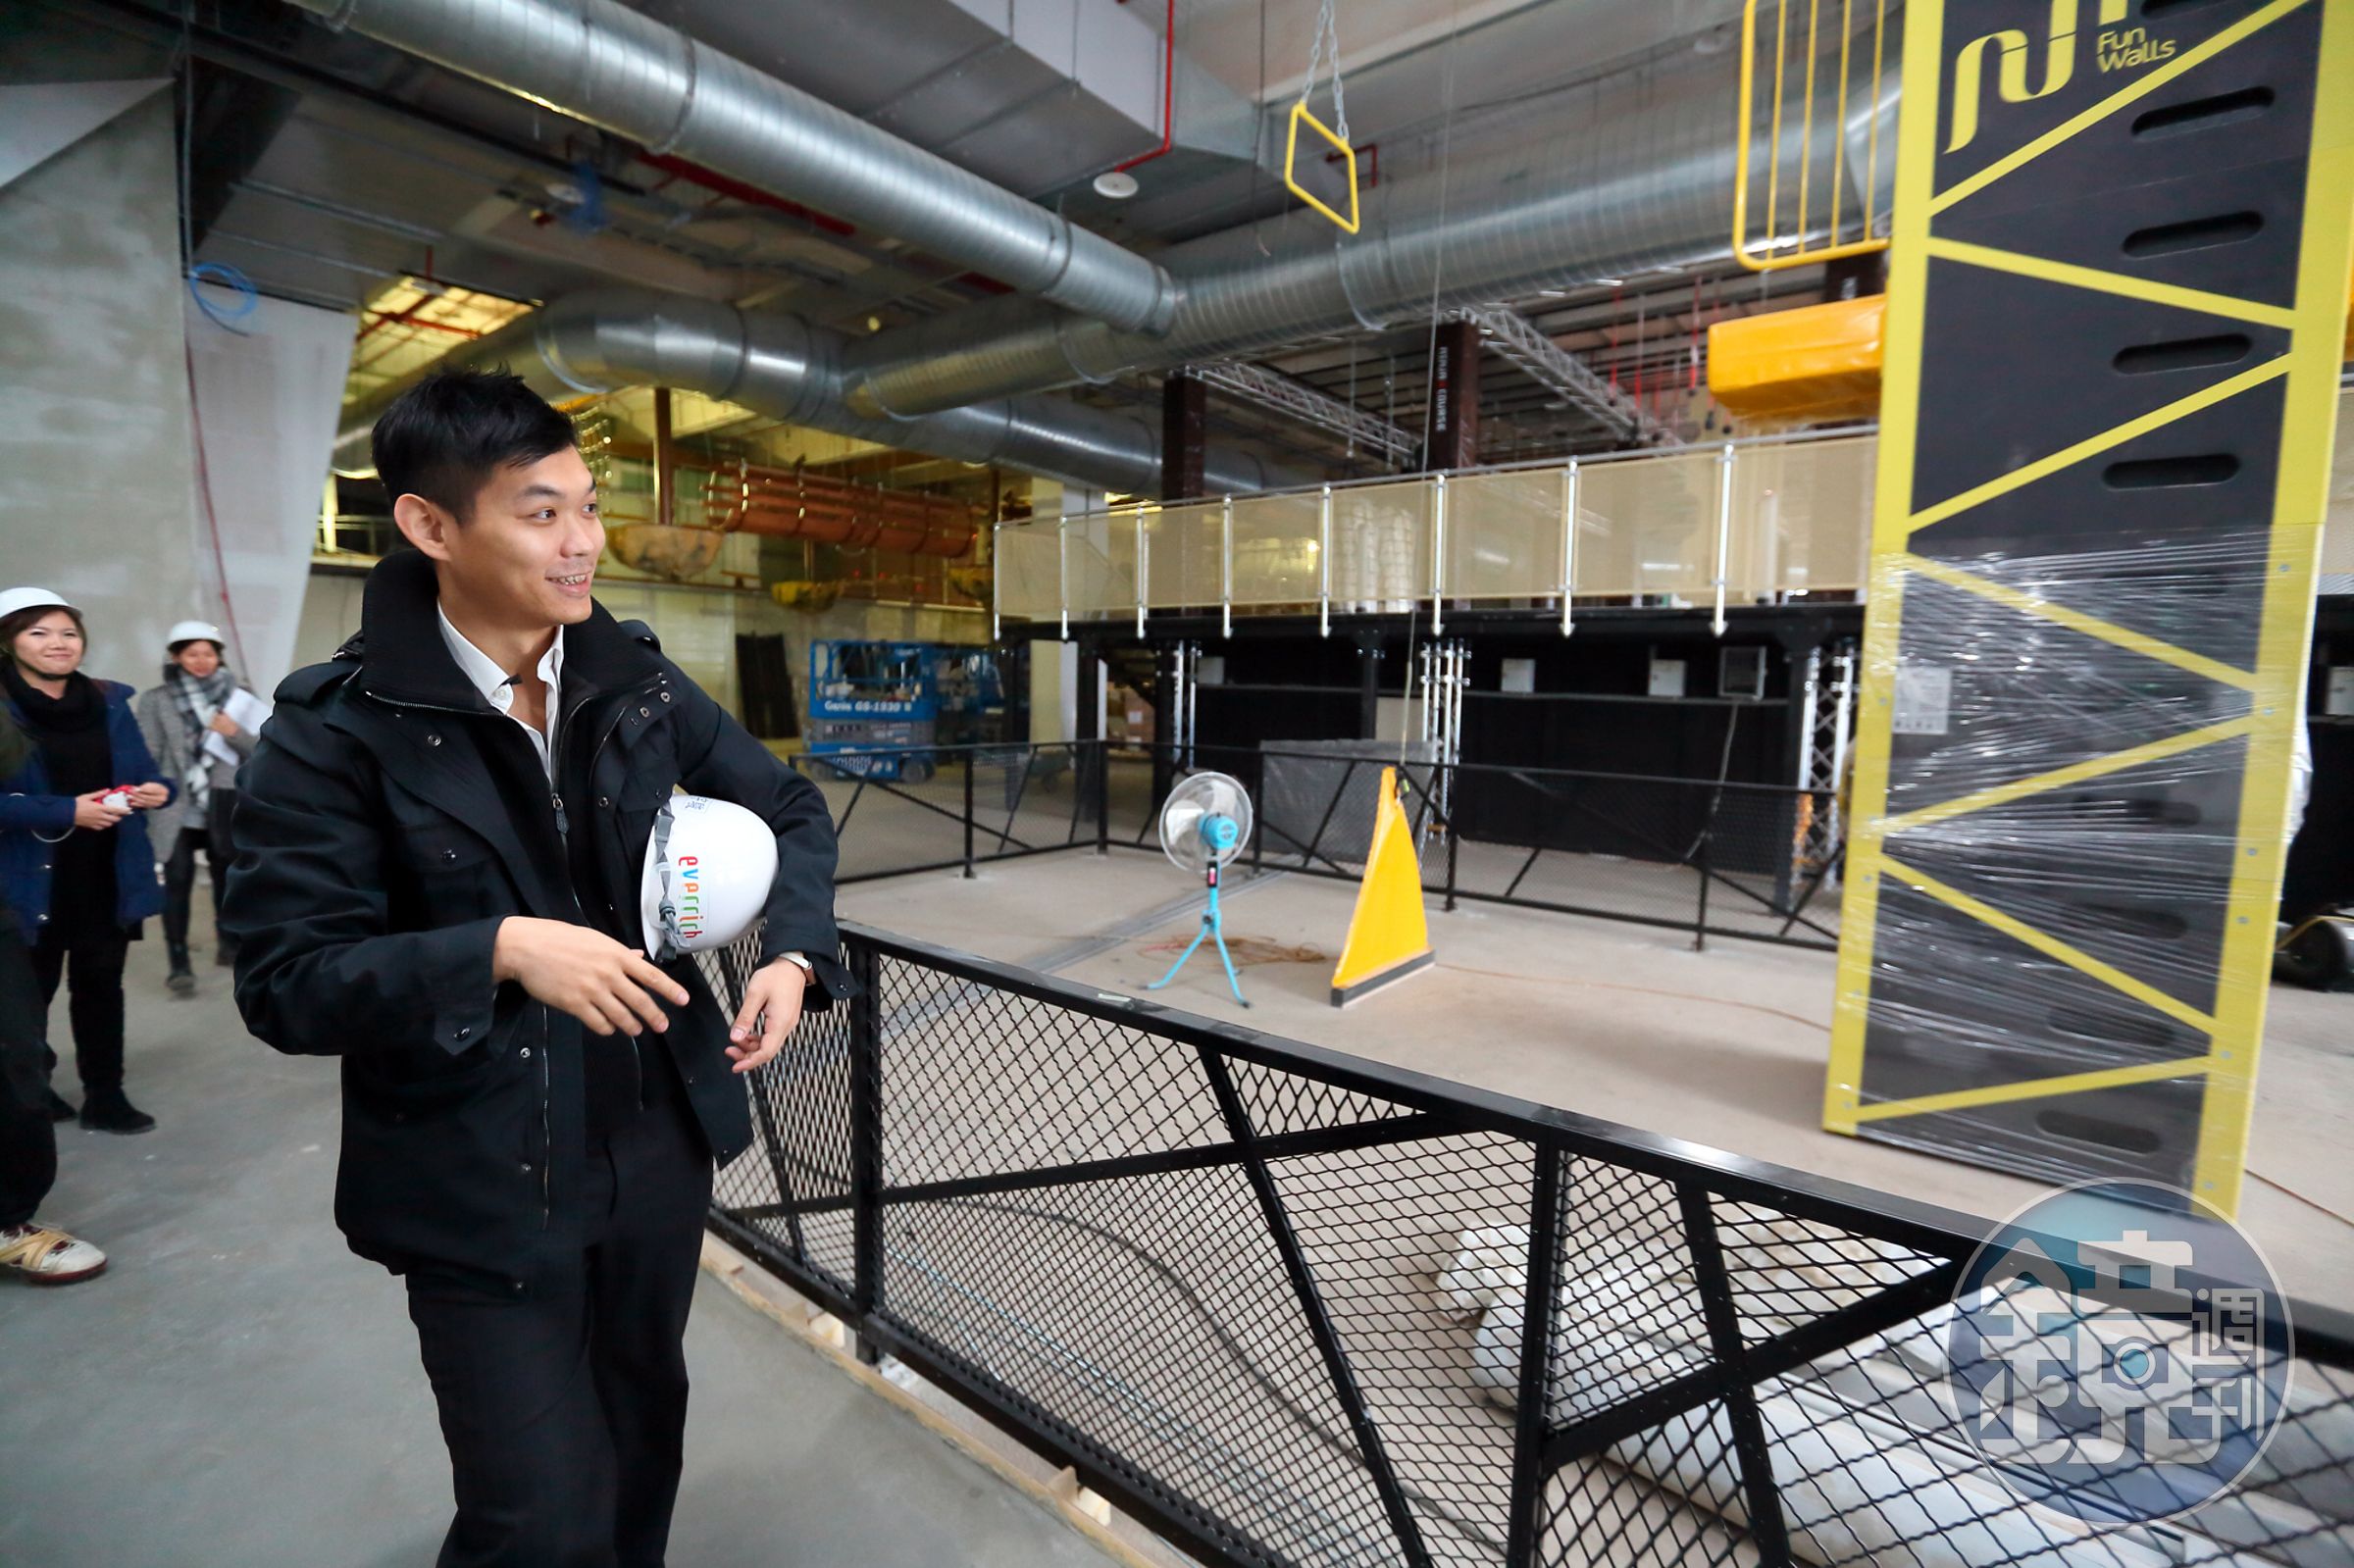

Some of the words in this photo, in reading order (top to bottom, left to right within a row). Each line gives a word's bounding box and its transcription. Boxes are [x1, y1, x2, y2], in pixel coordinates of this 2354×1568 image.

[2097, 26, 2146, 55] Fun
[2097, 39, 2177, 74] Walls
[1437, 388, 1447, 431] COURSE
[679, 856, 703, 938] everrich
